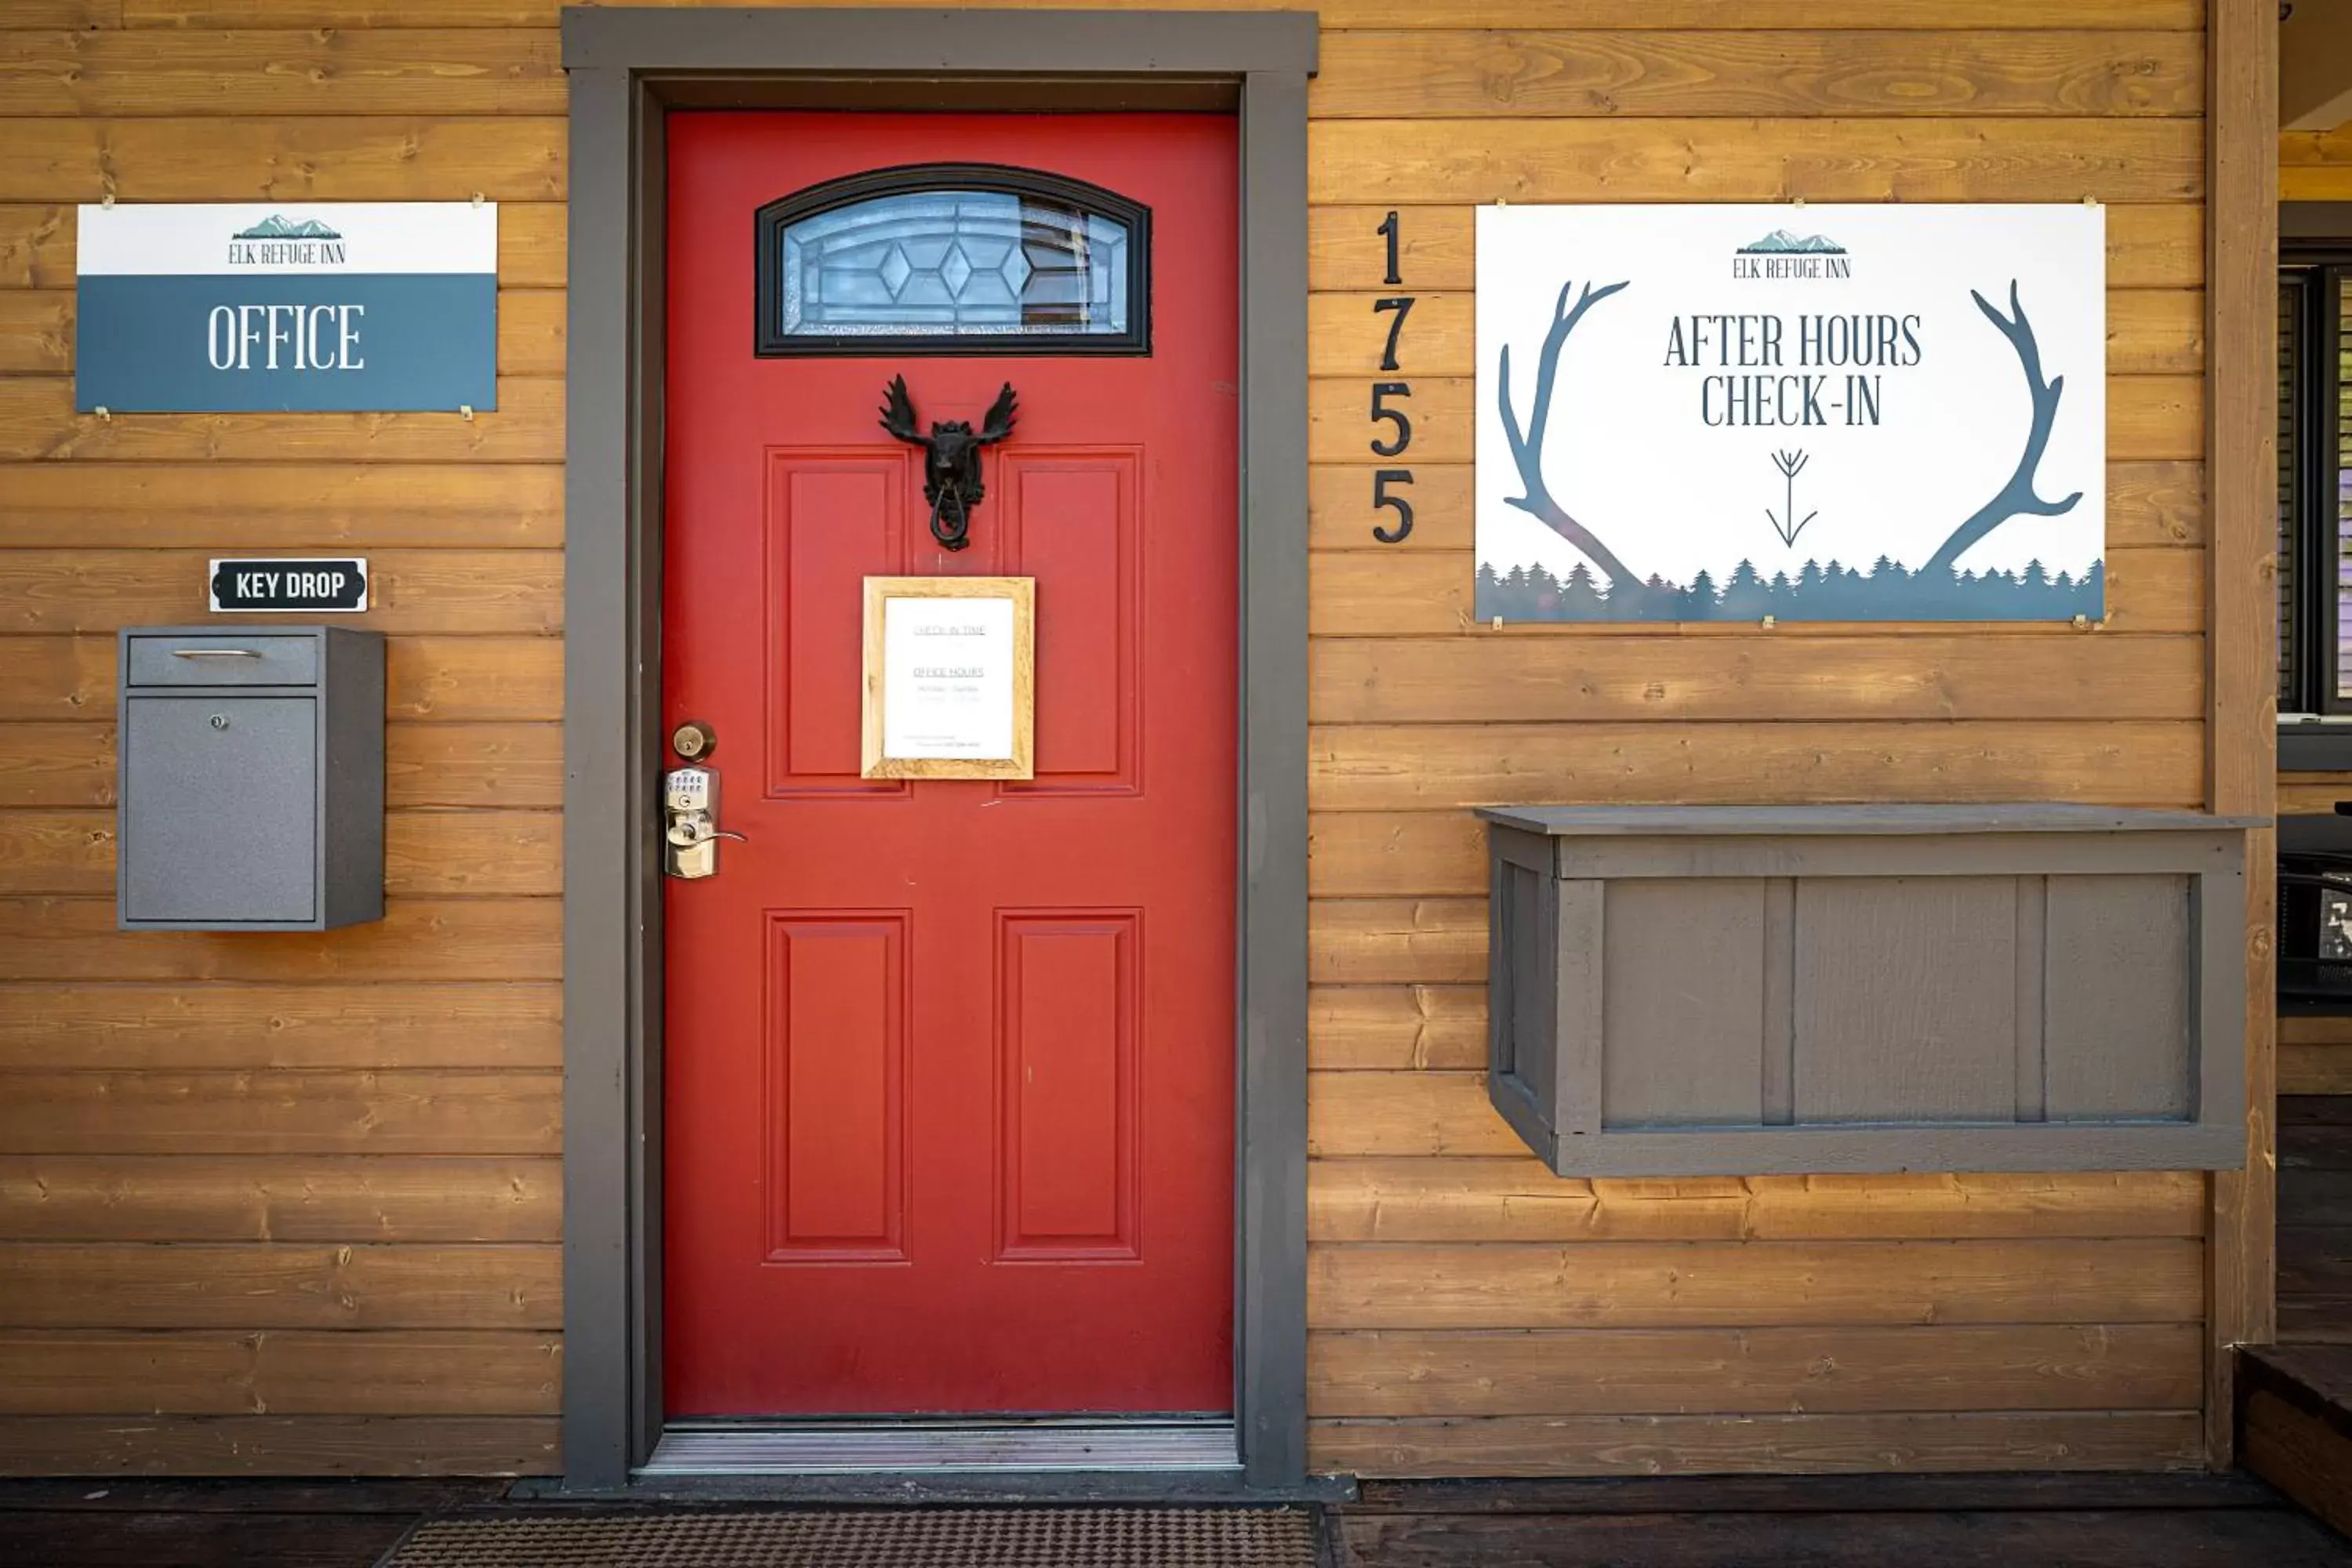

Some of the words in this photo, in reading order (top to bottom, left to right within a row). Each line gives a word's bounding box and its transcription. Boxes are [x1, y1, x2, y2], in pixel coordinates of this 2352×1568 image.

[228, 243, 256, 265] ELK
[261, 243, 316, 265] REFUGE
[321, 243, 346, 265] INN
[1733, 258, 1761, 278] ELK
[1766, 258, 1821, 278] REFUGE
[1826, 258, 1851, 278] INN
[207, 303, 365, 372] OFFICE
[1663, 314, 1784, 367] AFTER
[1798, 314, 1922, 367] HOURS
[1701, 374, 1882, 427] CHECK-IN
[236, 571, 281, 600] KEY
[285, 571, 346, 600] DROP
